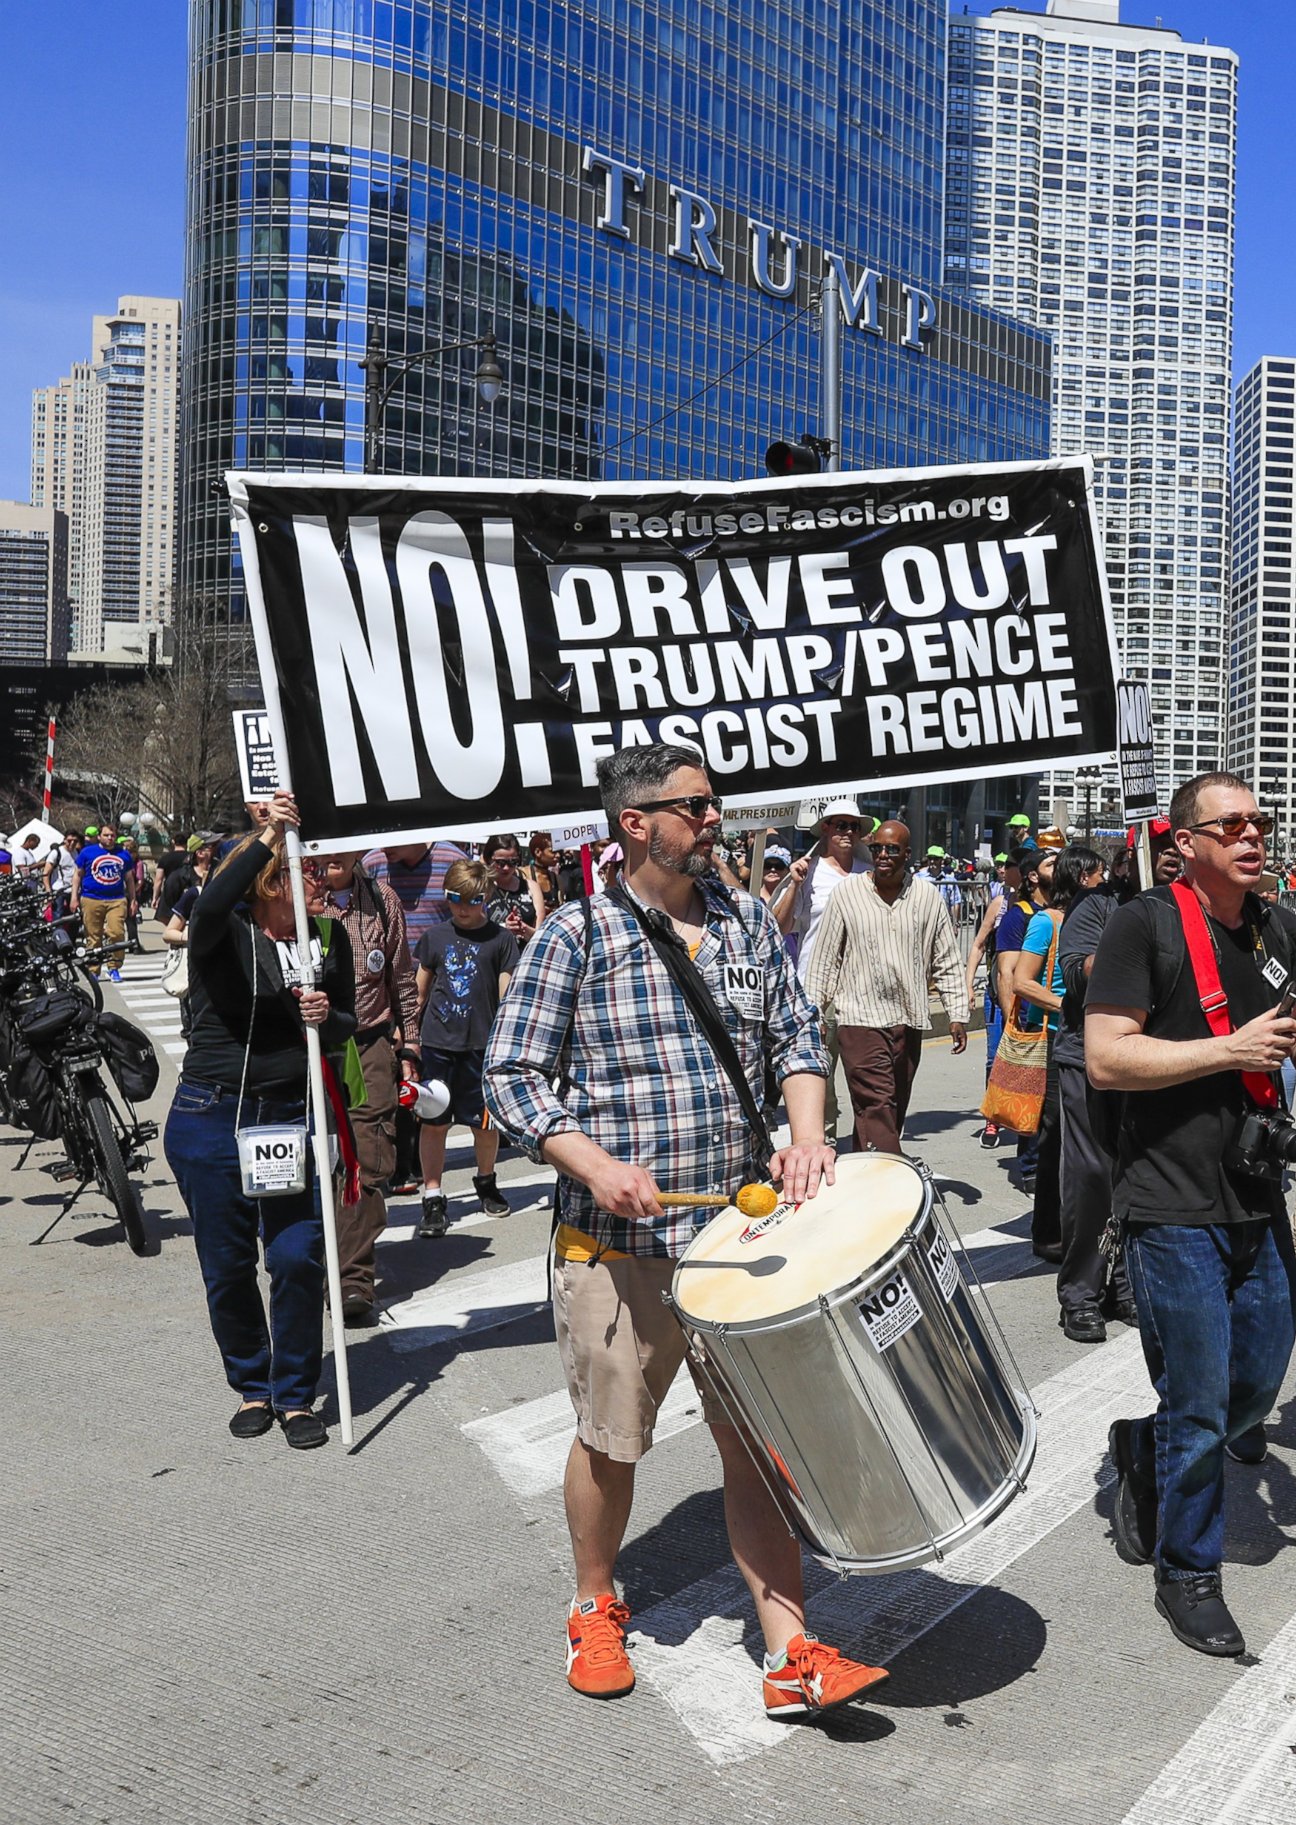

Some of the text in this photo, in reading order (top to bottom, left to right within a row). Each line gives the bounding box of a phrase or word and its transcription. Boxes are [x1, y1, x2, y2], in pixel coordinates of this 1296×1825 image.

[583, 145, 936, 352] TRUMP
[609, 495, 1010, 539] RefuseFascism.org
[548, 535, 1058, 640] DRIVE OUT
[293, 510, 552, 806] NO!
[559, 613, 1074, 713] TRUMP/PENCE
[865, 679, 1083, 757] REGIME
[1119, 685, 1152, 743] NO!
[723, 806, 795, 820] MR. PRESIDENT
[727, 968, 762, 991] NO!
[1265, 961, 1286, 984] NO!
[255, 1143, 294, 1161] NO!
[859, 1274, 908, 1325] NO!
[872, 1320, 891, 1336] REFUSE
[880, 1321, 898, 1338] FASCIST
